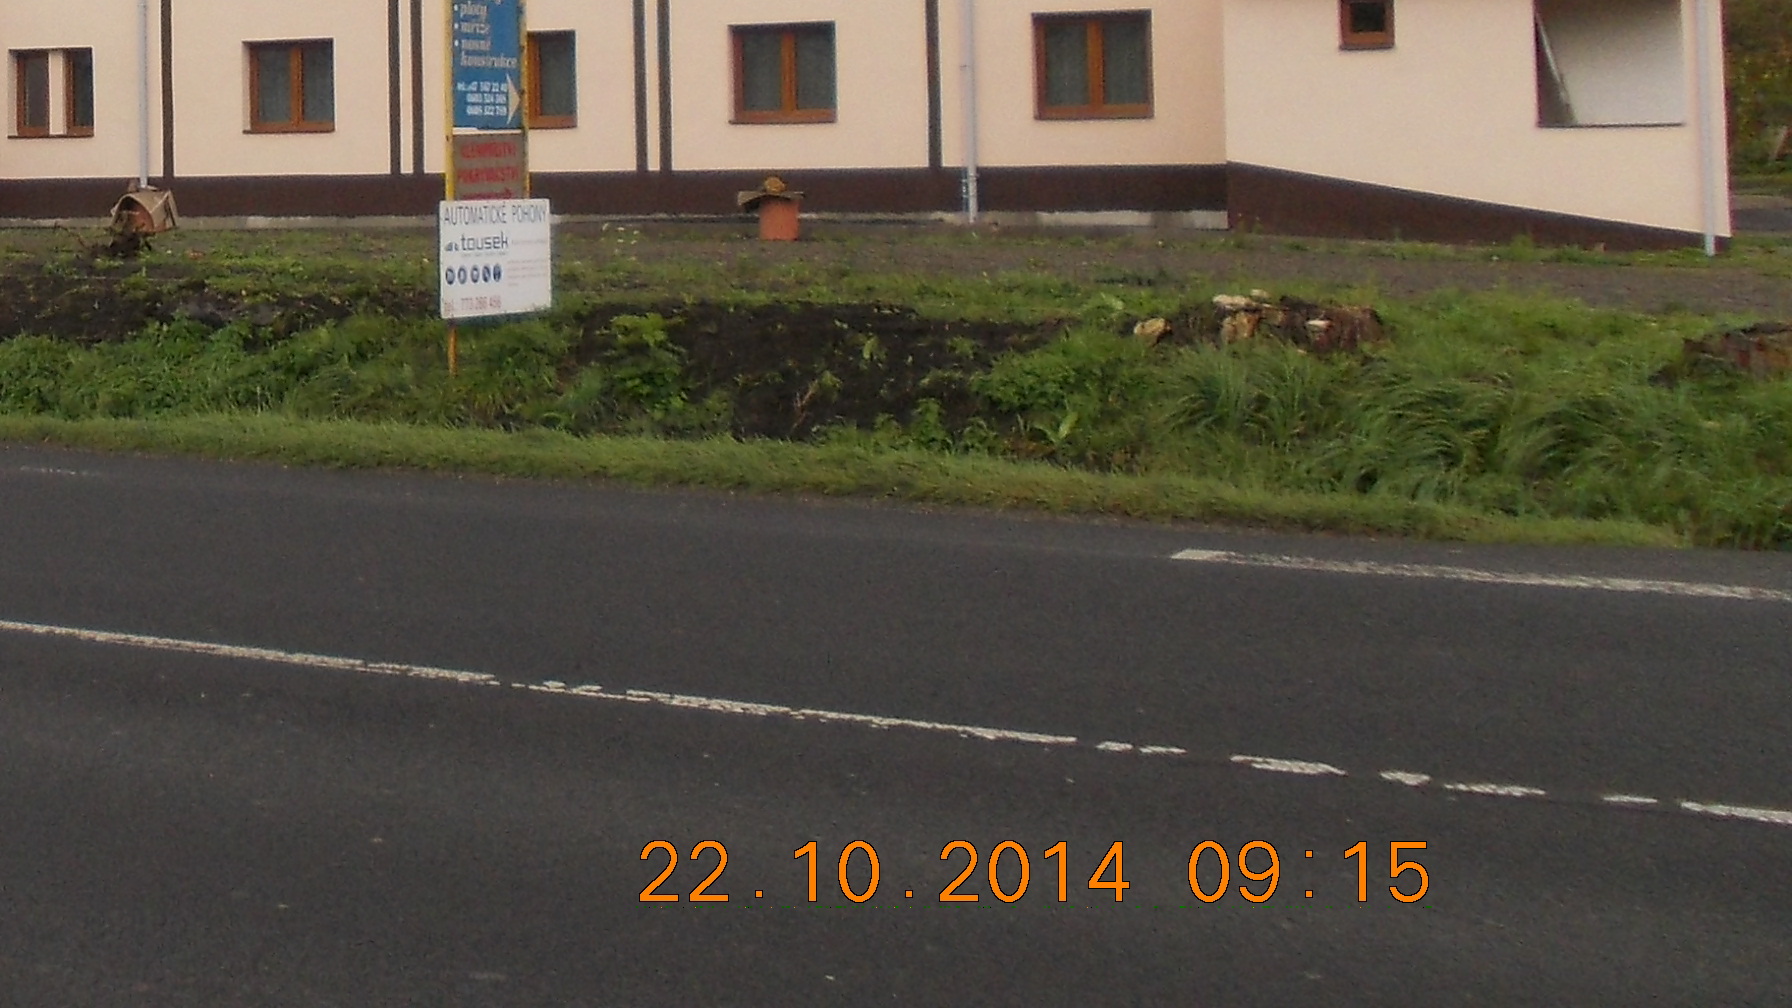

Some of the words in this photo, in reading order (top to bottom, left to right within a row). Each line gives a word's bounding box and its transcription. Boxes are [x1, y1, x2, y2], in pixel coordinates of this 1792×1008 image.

[443, 201, 507, 226] AUTOMATICKÉ
[512, 204, 546, 224] POHONY
[461, 230, 508, 251] tousek
